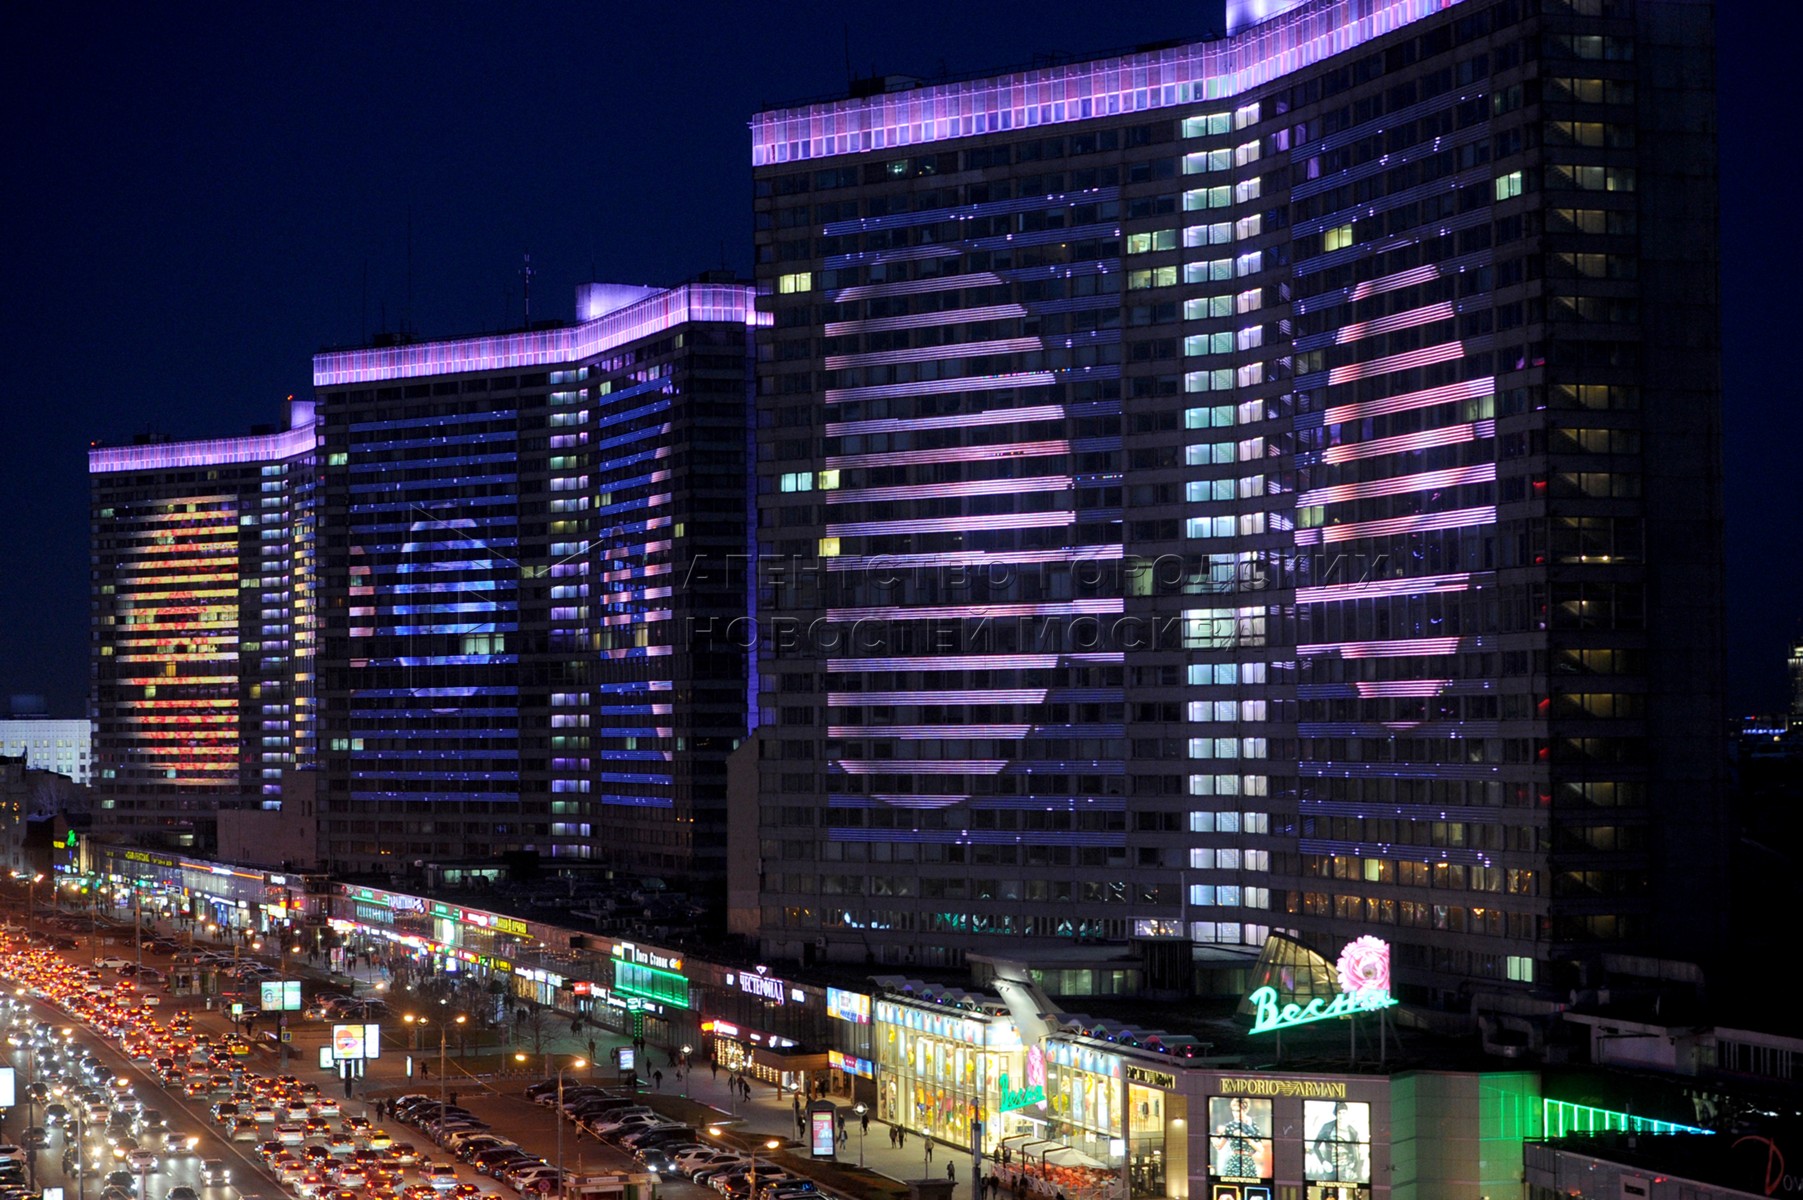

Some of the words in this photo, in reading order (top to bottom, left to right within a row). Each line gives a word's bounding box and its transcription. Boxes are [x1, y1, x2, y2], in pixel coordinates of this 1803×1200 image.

[1248, 986, 1399, 1035] Весна
[998, 1072, 1046, 1112] Весна
[1220, 1077, 1280, 1096] EMPORIO
[1294, 1081, 1346, 1098] ARMANI
